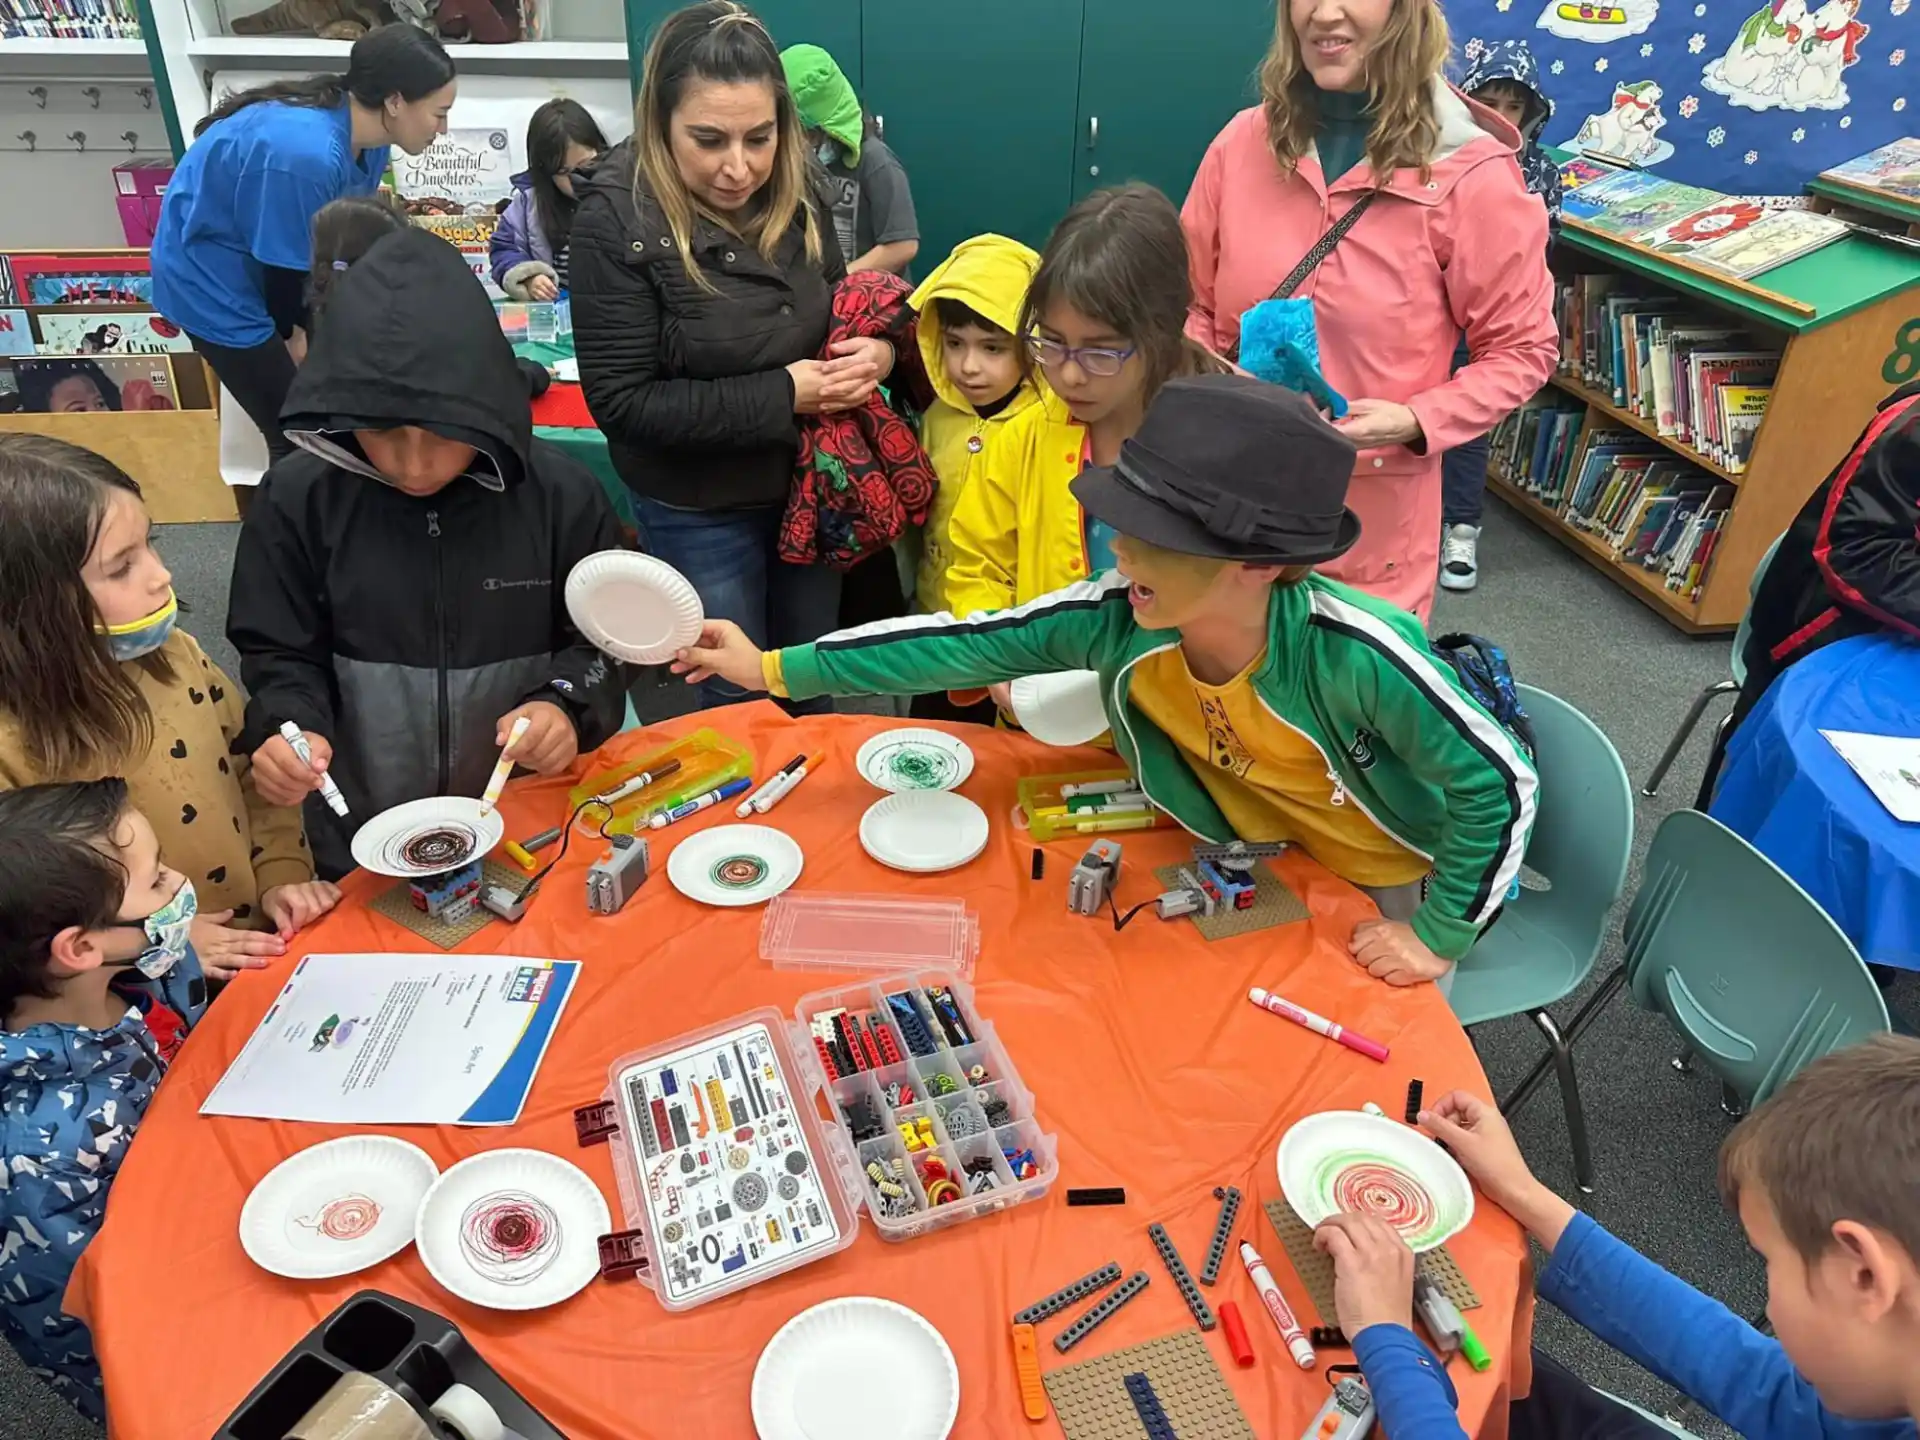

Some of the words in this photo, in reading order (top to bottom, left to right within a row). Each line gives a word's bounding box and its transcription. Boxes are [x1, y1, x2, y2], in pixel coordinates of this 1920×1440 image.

[424, 150, 490, 173] Beautiful
[405, 170, 482, 195] Daughters
[1881, 317, 1920, 385] 8
[482, 578, 552, 590] Champion
